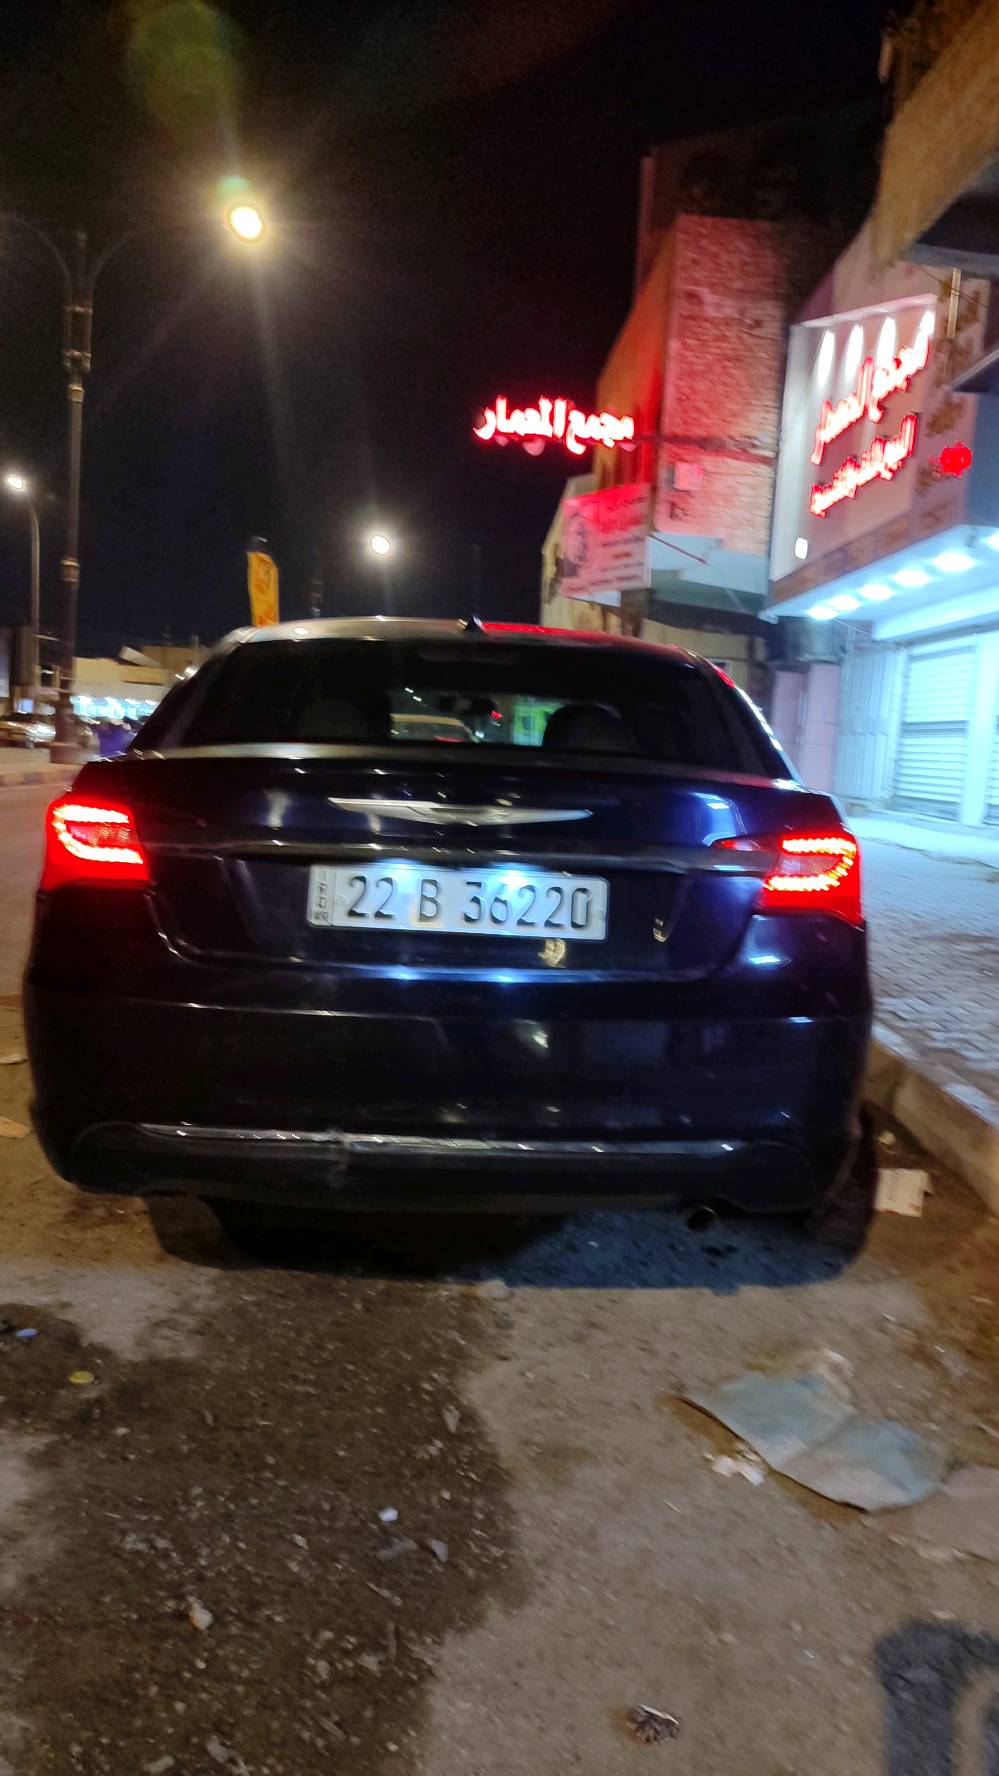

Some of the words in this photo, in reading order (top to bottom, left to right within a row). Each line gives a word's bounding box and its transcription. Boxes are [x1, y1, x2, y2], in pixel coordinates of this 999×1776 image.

[348, 874, 398, 920] 22
[418, 879, 439, 922] B
[463, 880, 591, 930] 36220
